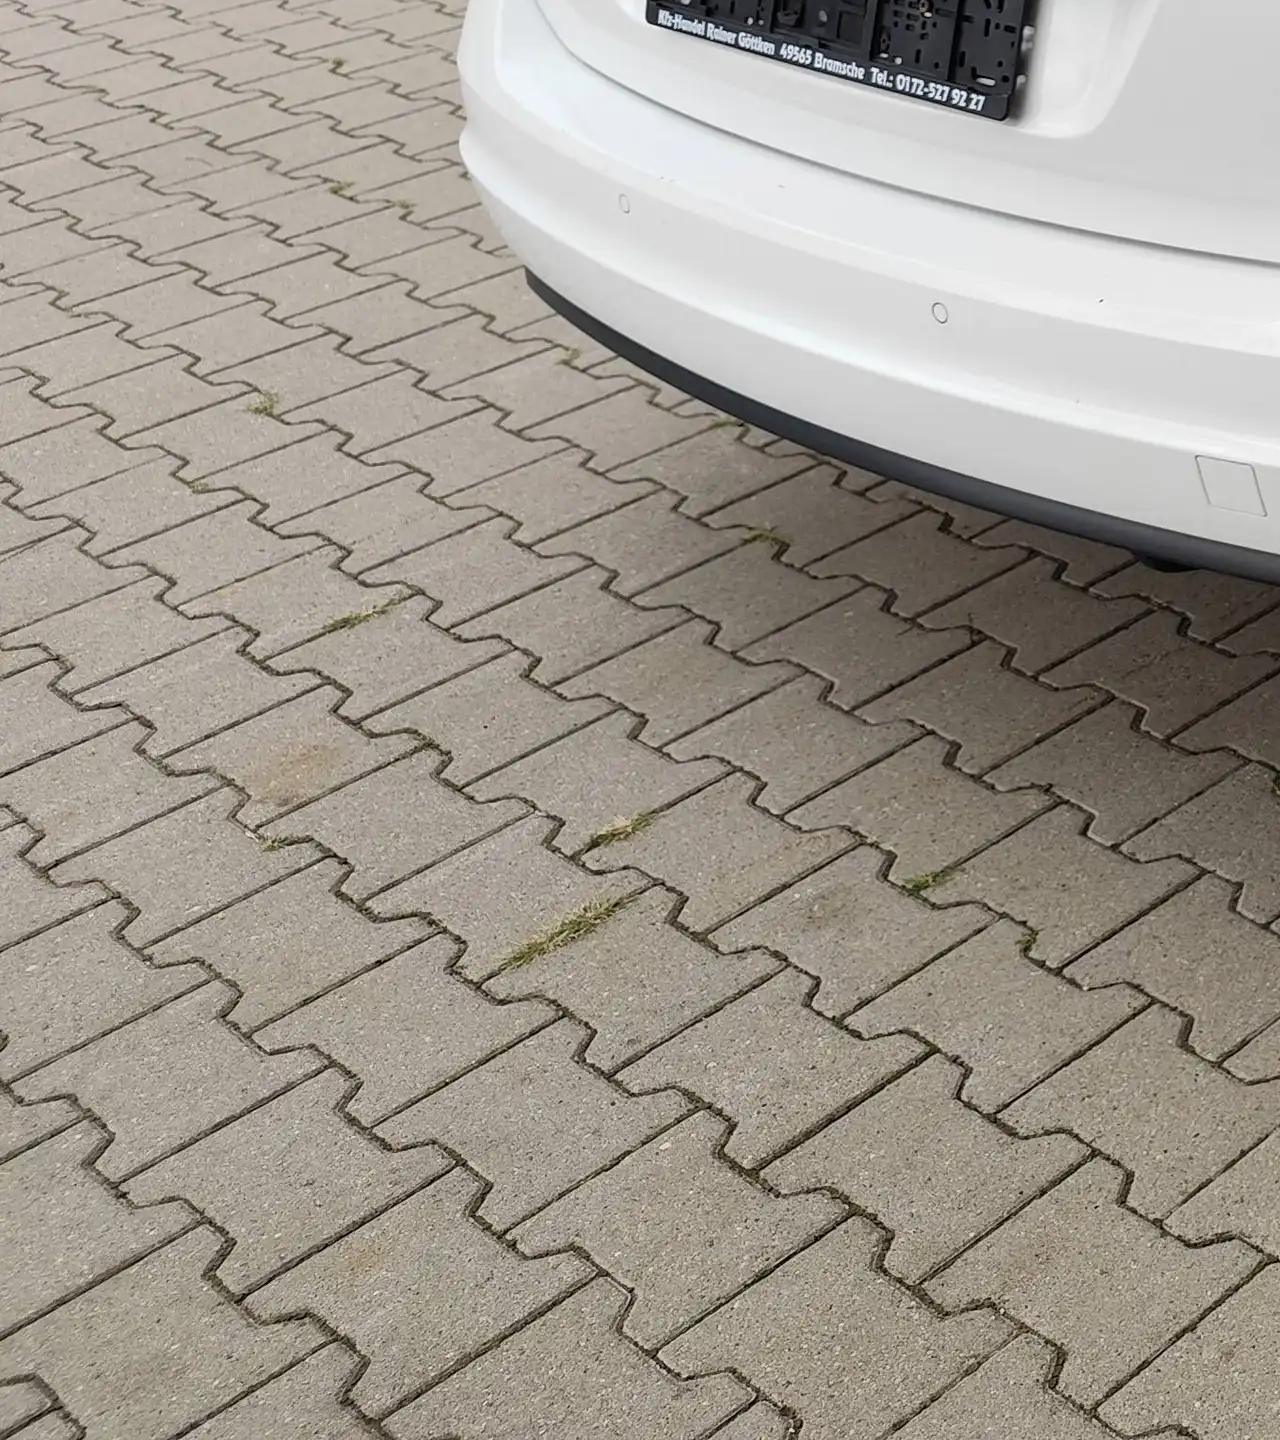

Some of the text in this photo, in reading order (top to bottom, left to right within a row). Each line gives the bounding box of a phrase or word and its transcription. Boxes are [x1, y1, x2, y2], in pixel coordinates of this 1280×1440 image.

[657, 9, 706, 37] Kfz-Handel
[780, 42, 813, 66] 49565
[814, 51, 866, 80] Bramsche
[870, 66, 894, 88] Tel.:
[895, 73, 951, 102] 0172-527
[951, 88, 967, 107] 92
[968, 93, 986, 111] 27
